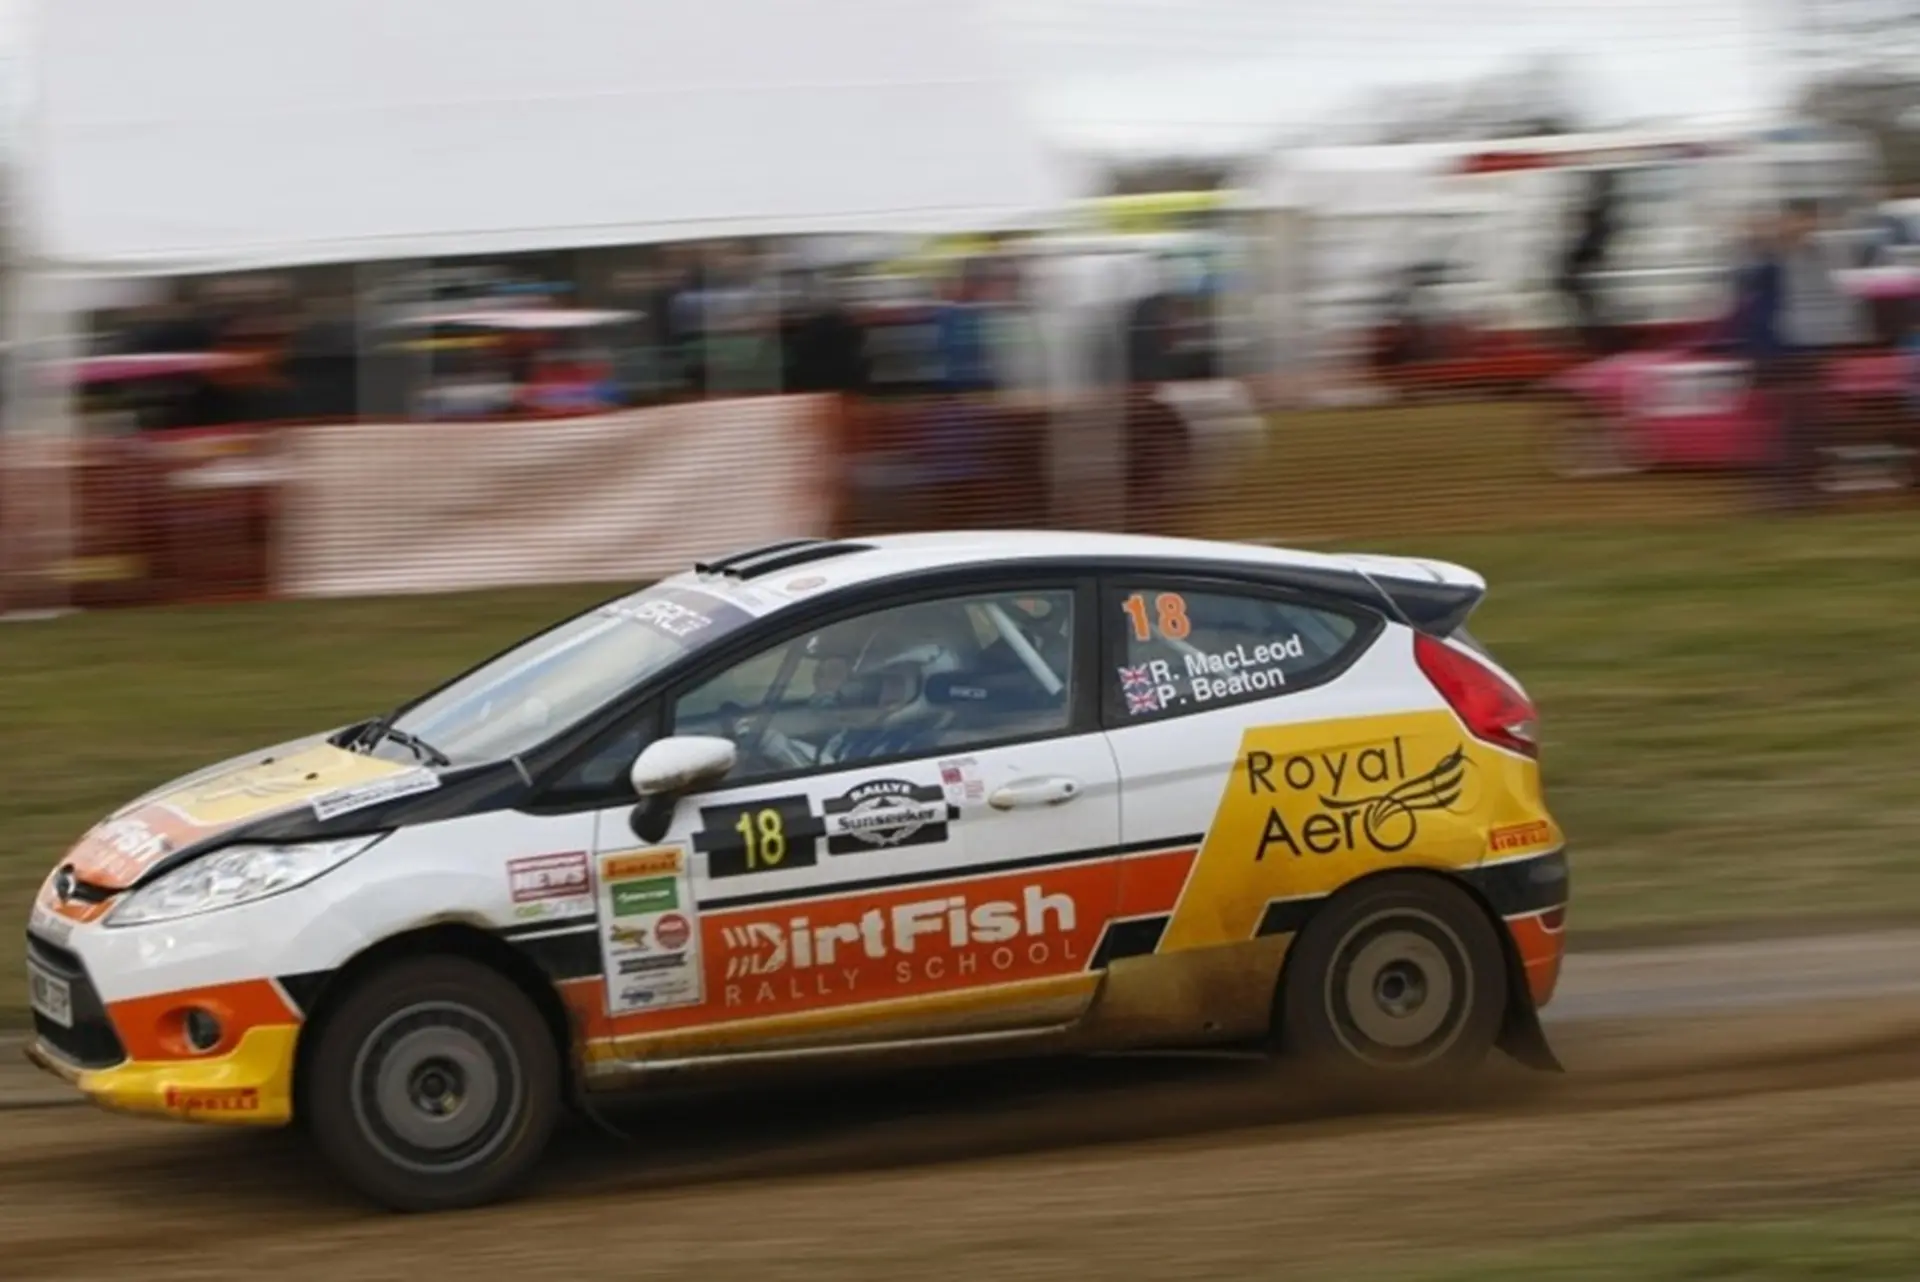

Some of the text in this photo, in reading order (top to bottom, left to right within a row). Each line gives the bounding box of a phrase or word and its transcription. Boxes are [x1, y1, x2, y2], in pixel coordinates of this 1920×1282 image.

[1122, 592, 1191, 641] 18
[1150, 634, 1304, 684] R. MacLeod
[1157, 665, 1285, 709] P. Beaton
[850, 782, 911, 801] RALLYE
[1247, 737, 1407, 796] Royal
[735, 809, 786, 869] 18
[838, 808, 936, 830] Sunseeker
[1255, 806, 1417, 862] Aero
[721, 884, 1077, 980] DirtFish
[725, 969, 860, 1007] RALLY
[896, 941, 1077, 983] SCHOOL
